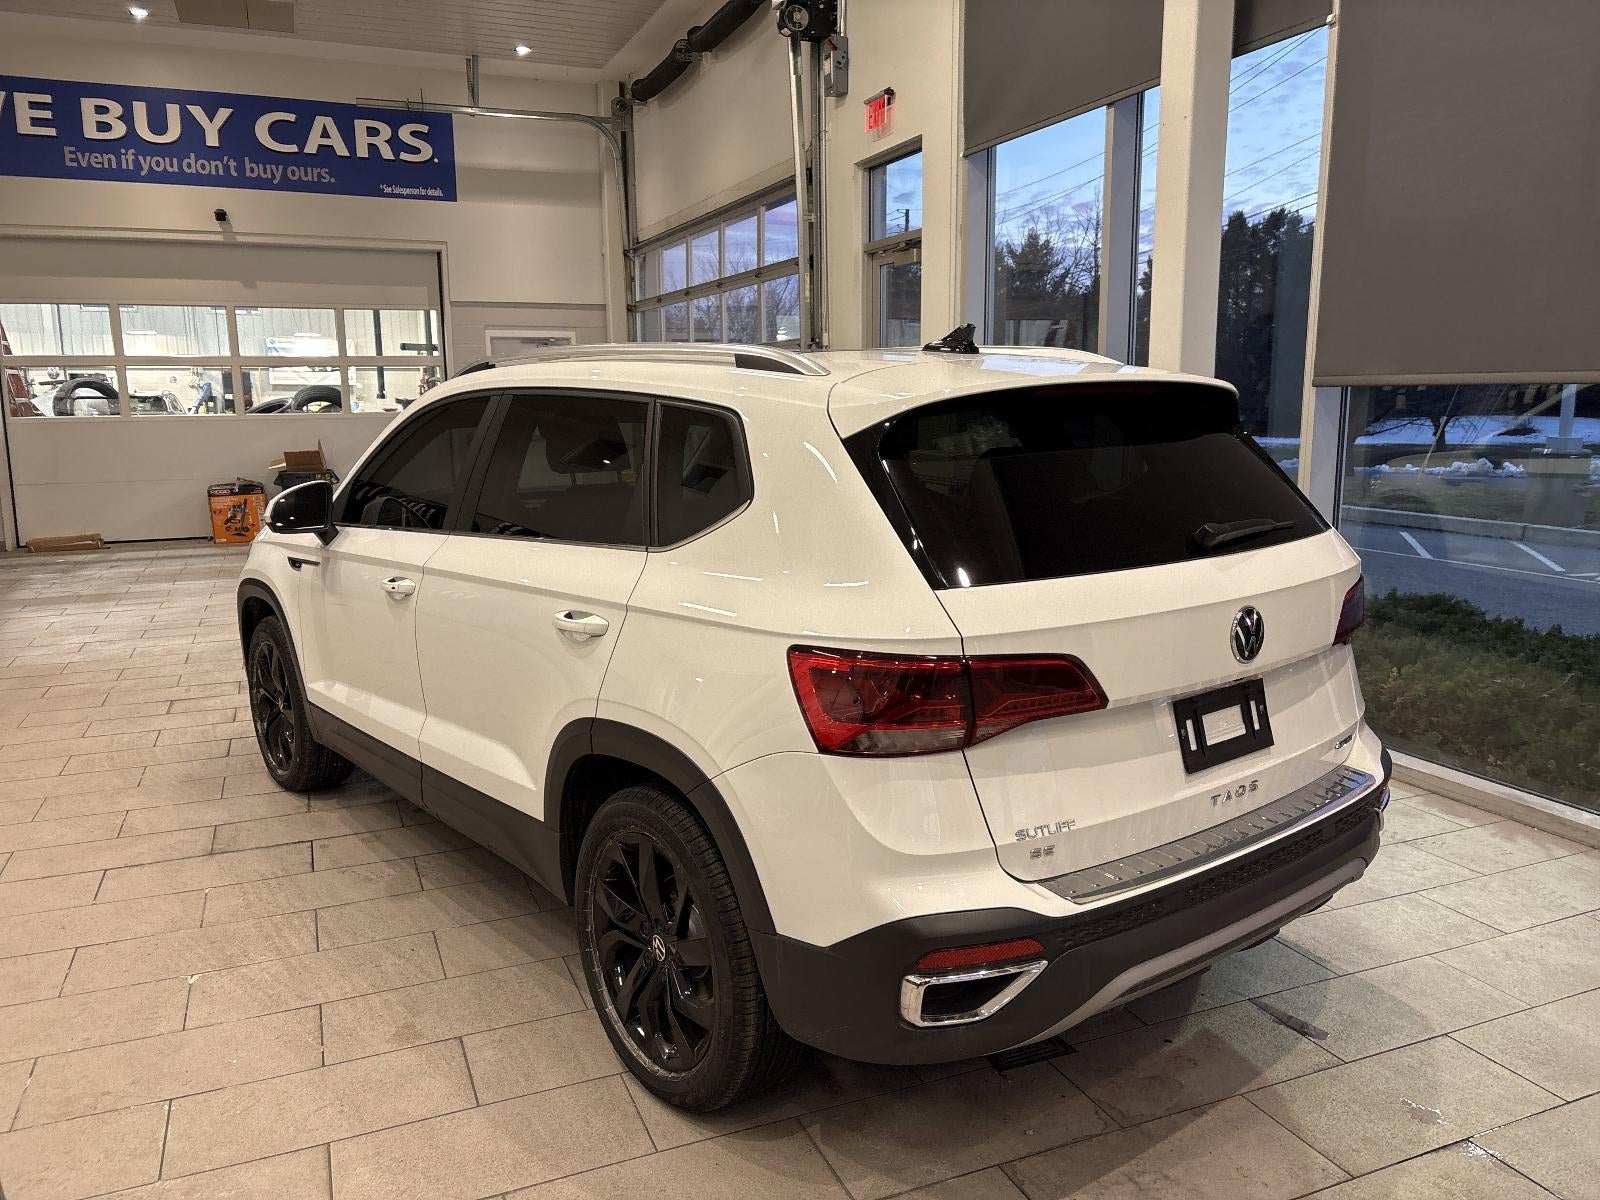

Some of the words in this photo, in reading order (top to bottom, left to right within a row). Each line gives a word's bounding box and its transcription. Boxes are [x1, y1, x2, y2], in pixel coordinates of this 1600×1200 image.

[0, 91, 57, 136] E
[80, 97, 233, 147] BUY
[254, 111, 439, 163] CARS.
[63, 145, 117, 169] Even
[121, 148, 135, 170] if
[138, 155, 179, 176] you
[182, 152, 237, 177] don't
[245, 156, 283, 185] buy
[287, 164, 335, 183] ours.
[392, 185, 419, 197] Salesperson
[1211, 779, 1259, 807] TAOS
[1015, 818, 1076, 842] SUTLIFF
[1029, 844, 1056, 859] SE
